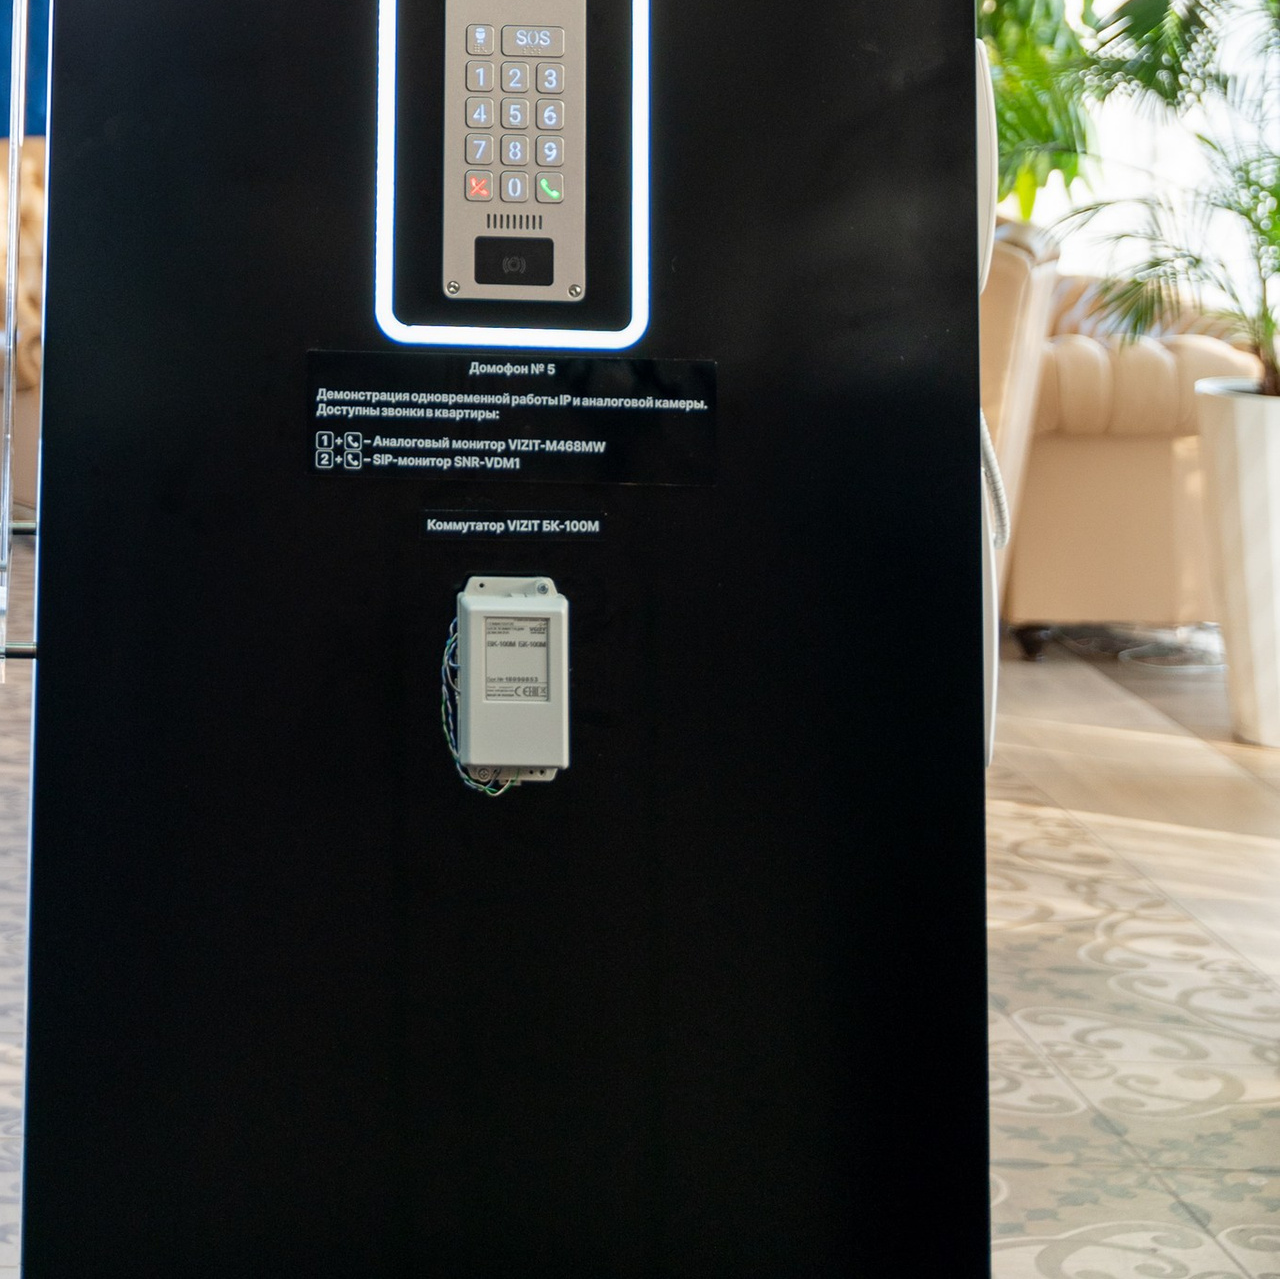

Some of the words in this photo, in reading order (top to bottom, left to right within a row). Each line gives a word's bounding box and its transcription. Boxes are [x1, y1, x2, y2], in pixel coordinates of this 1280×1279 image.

[516, 30, 551, 45] SOS
[476, 67, 484, 86] 1
[509, 68, 521, 87] 2
[544, 69, 557, 88] 3
[473, 104, 486, 123] 4
[510, 105, 521, 123] 5
[544, 106, 557, 125] 6
[473, 140, 486, 159] 7
[509, 141, 521, 160] 8
[544, 142, 557, 161] 9
[508, 178, 521, 197] 0
[469, 362, 528, 376] Домофон
[531, 363, 545, 374] №
[547, 364, 556, 375] 5
[316, 388, 409, 404] Демонстрация
[411, 391, 509, 406] одновременной
[511, 393, 558, 407] работы
[560, 395, 571, 406] IP
[573, 397, 580, 406] и
[582, 395, 652, 409] аналоговой
[655, 398, 708, 412] камеры.
[316, 404, 380, 419] Доступны
[381, 407, 424, 418] звонки
[426, 409, 433, 418] в
[434, 409, 499, 420] квартиры:
[373, 435, 449, 450] Аналоговый
[452, 439, 506, 452] монитор
[508, 439, 606, 453] VIZIT-M468MW
[373, 454, 452, 469] SIP-монитор
[454, 456, 520, 469] SNR-VDM1
[427, 519, 504, 533] Коммутатор
[507, 520, 540, 532] VIZIT
